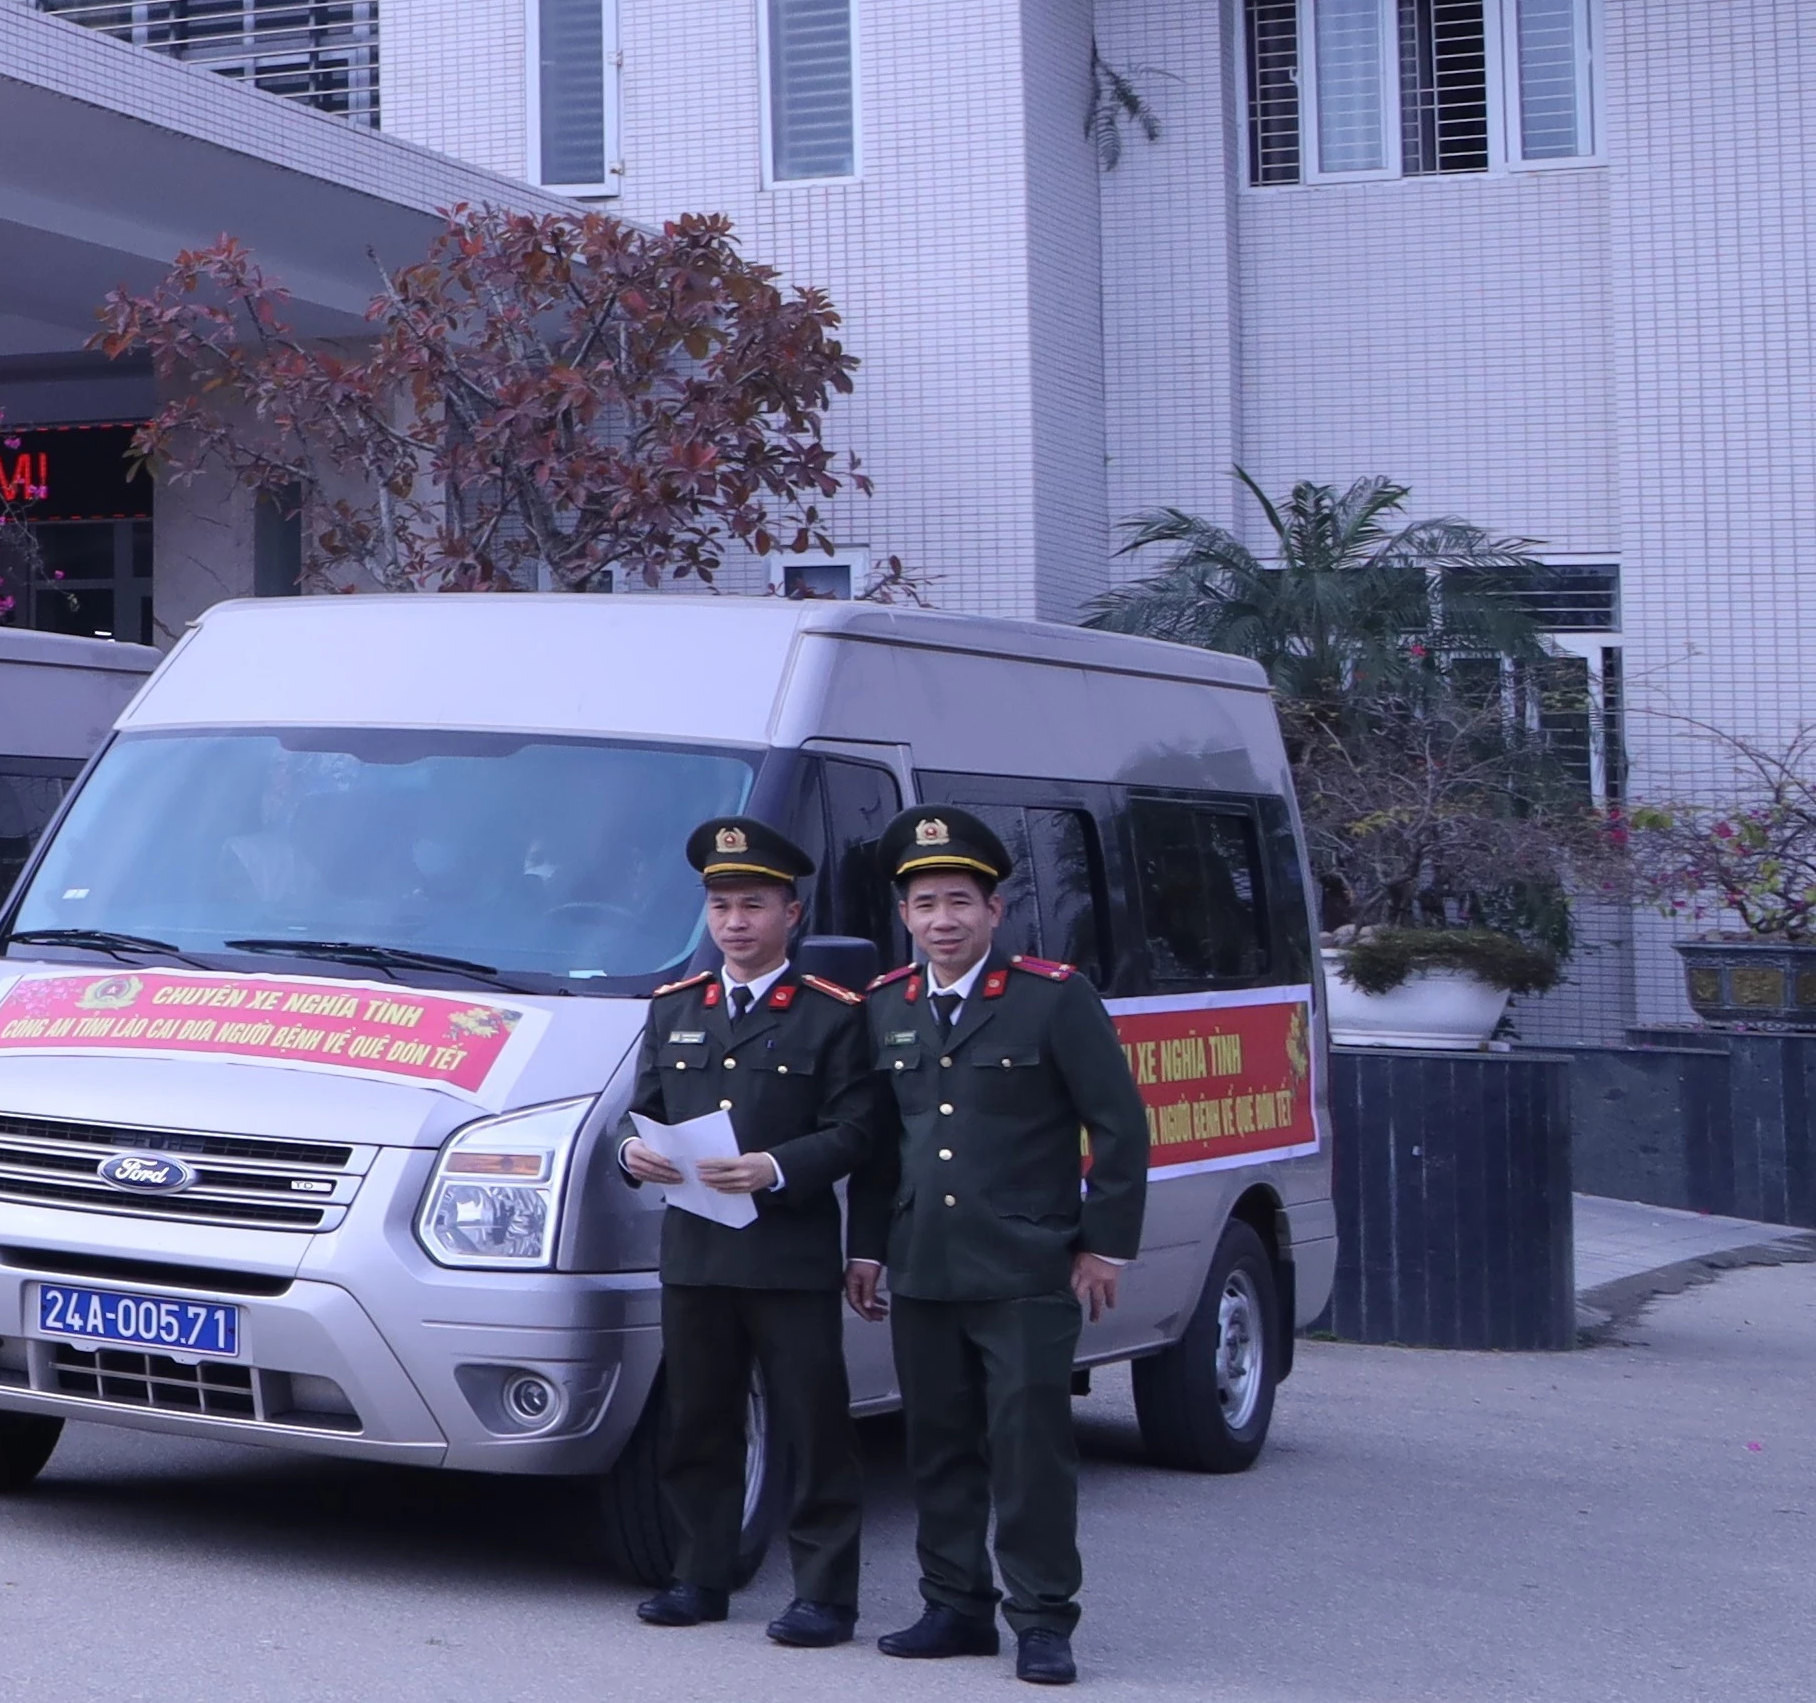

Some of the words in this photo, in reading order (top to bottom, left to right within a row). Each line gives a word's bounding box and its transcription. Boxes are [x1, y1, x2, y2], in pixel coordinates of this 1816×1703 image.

[151, 982, 247, 1008] CHUYẾN
[245, 990, 284, 1011] XE
[281, 993, 359, 1019] NGHĨA
[362, 999, 425, 1029] TÌNH
[0, 1015, 49, 1039] CÔNG
[44, 1017, 74, 1038] AN
[72, 1011, 112, 1038] TỈNH
[110, 1013, 149, 1039] LÀO
[146, 1018, 179, 1040] CAI
[176, 1018, 218, 1042] ĐƯA
[214, 1018, 276, 1046] NGƯỜI
[270, 1024, 325, 1053] BỆNH
[348, 1034, 391, 1059] QUÊ
[386, 1040, 429, 1066] ĐÓN
[429, 1041, 468, 1071] TẾT
[1136, 1041, 1157, 1085] XE
[1160, 1030, 1207, 1082] NGHĨA
[1208, 1026, 1242, 1077] TÌNH
[114, 1157, 170, 1184] Ford
[44, 1289, 227, 1349] 24A-005.71
